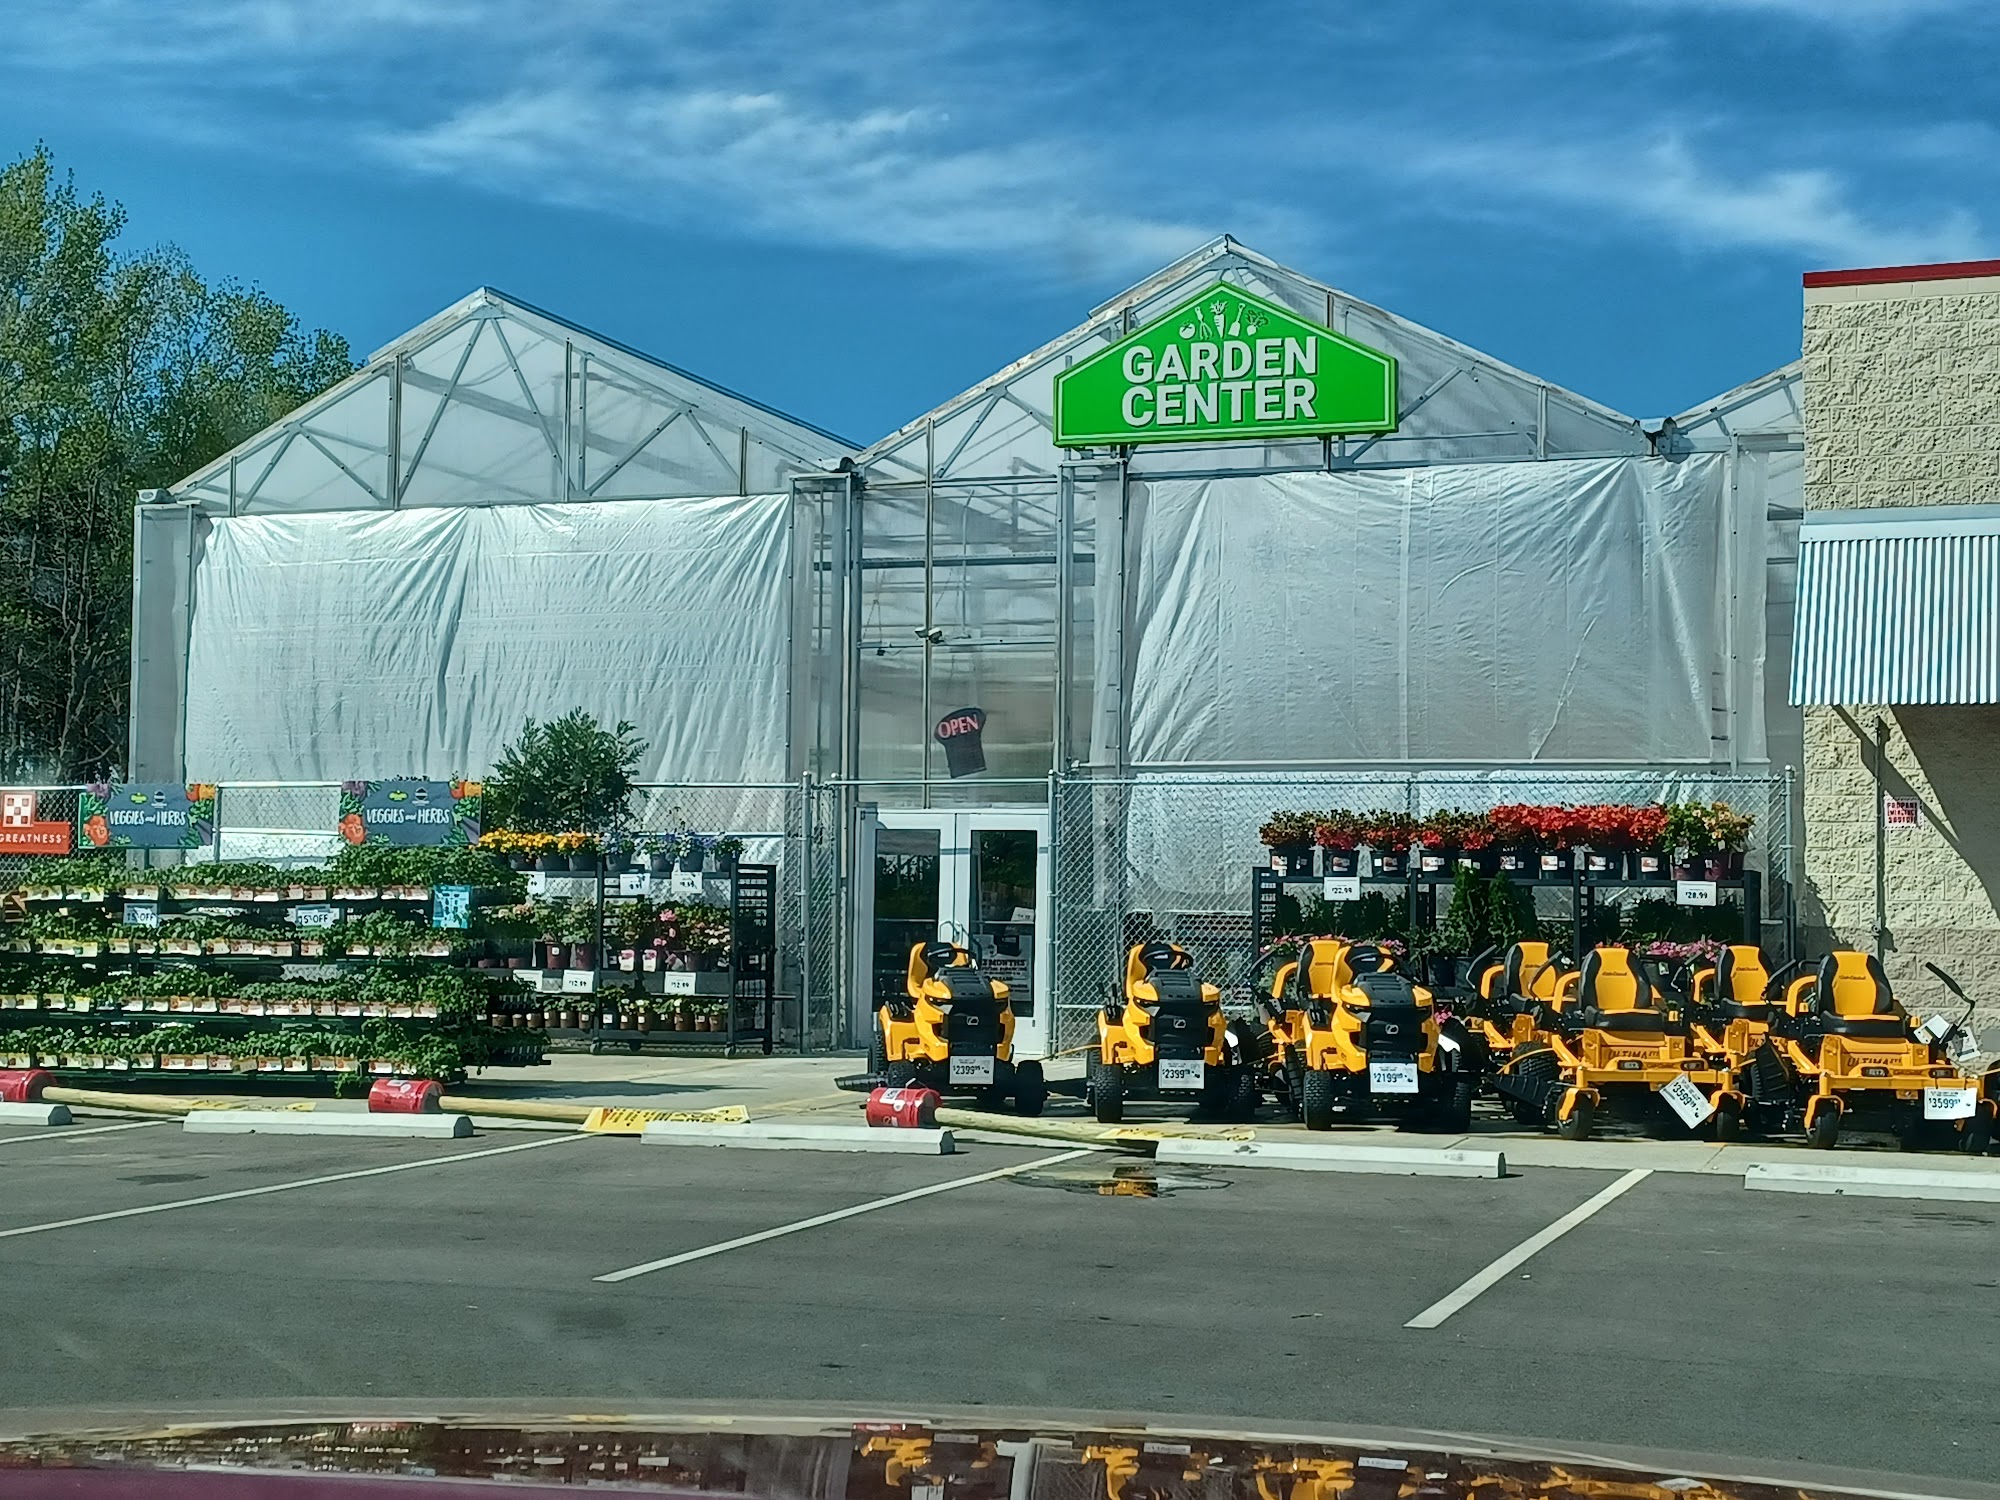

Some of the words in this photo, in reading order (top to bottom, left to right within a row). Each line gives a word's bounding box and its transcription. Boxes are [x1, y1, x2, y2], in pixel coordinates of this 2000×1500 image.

[1122, 336, 1318, 384] GARDEN
[1121, 379, 1317, 427] CENTER
[938, 714, 979, 738] OPEN
[109, 810, 145, 826] VEGGIES
[156, 810, 186, 826] HERBS
[366, 809, 405, 824] VEGGIES
[417, 808, 450, 824] HERBS
